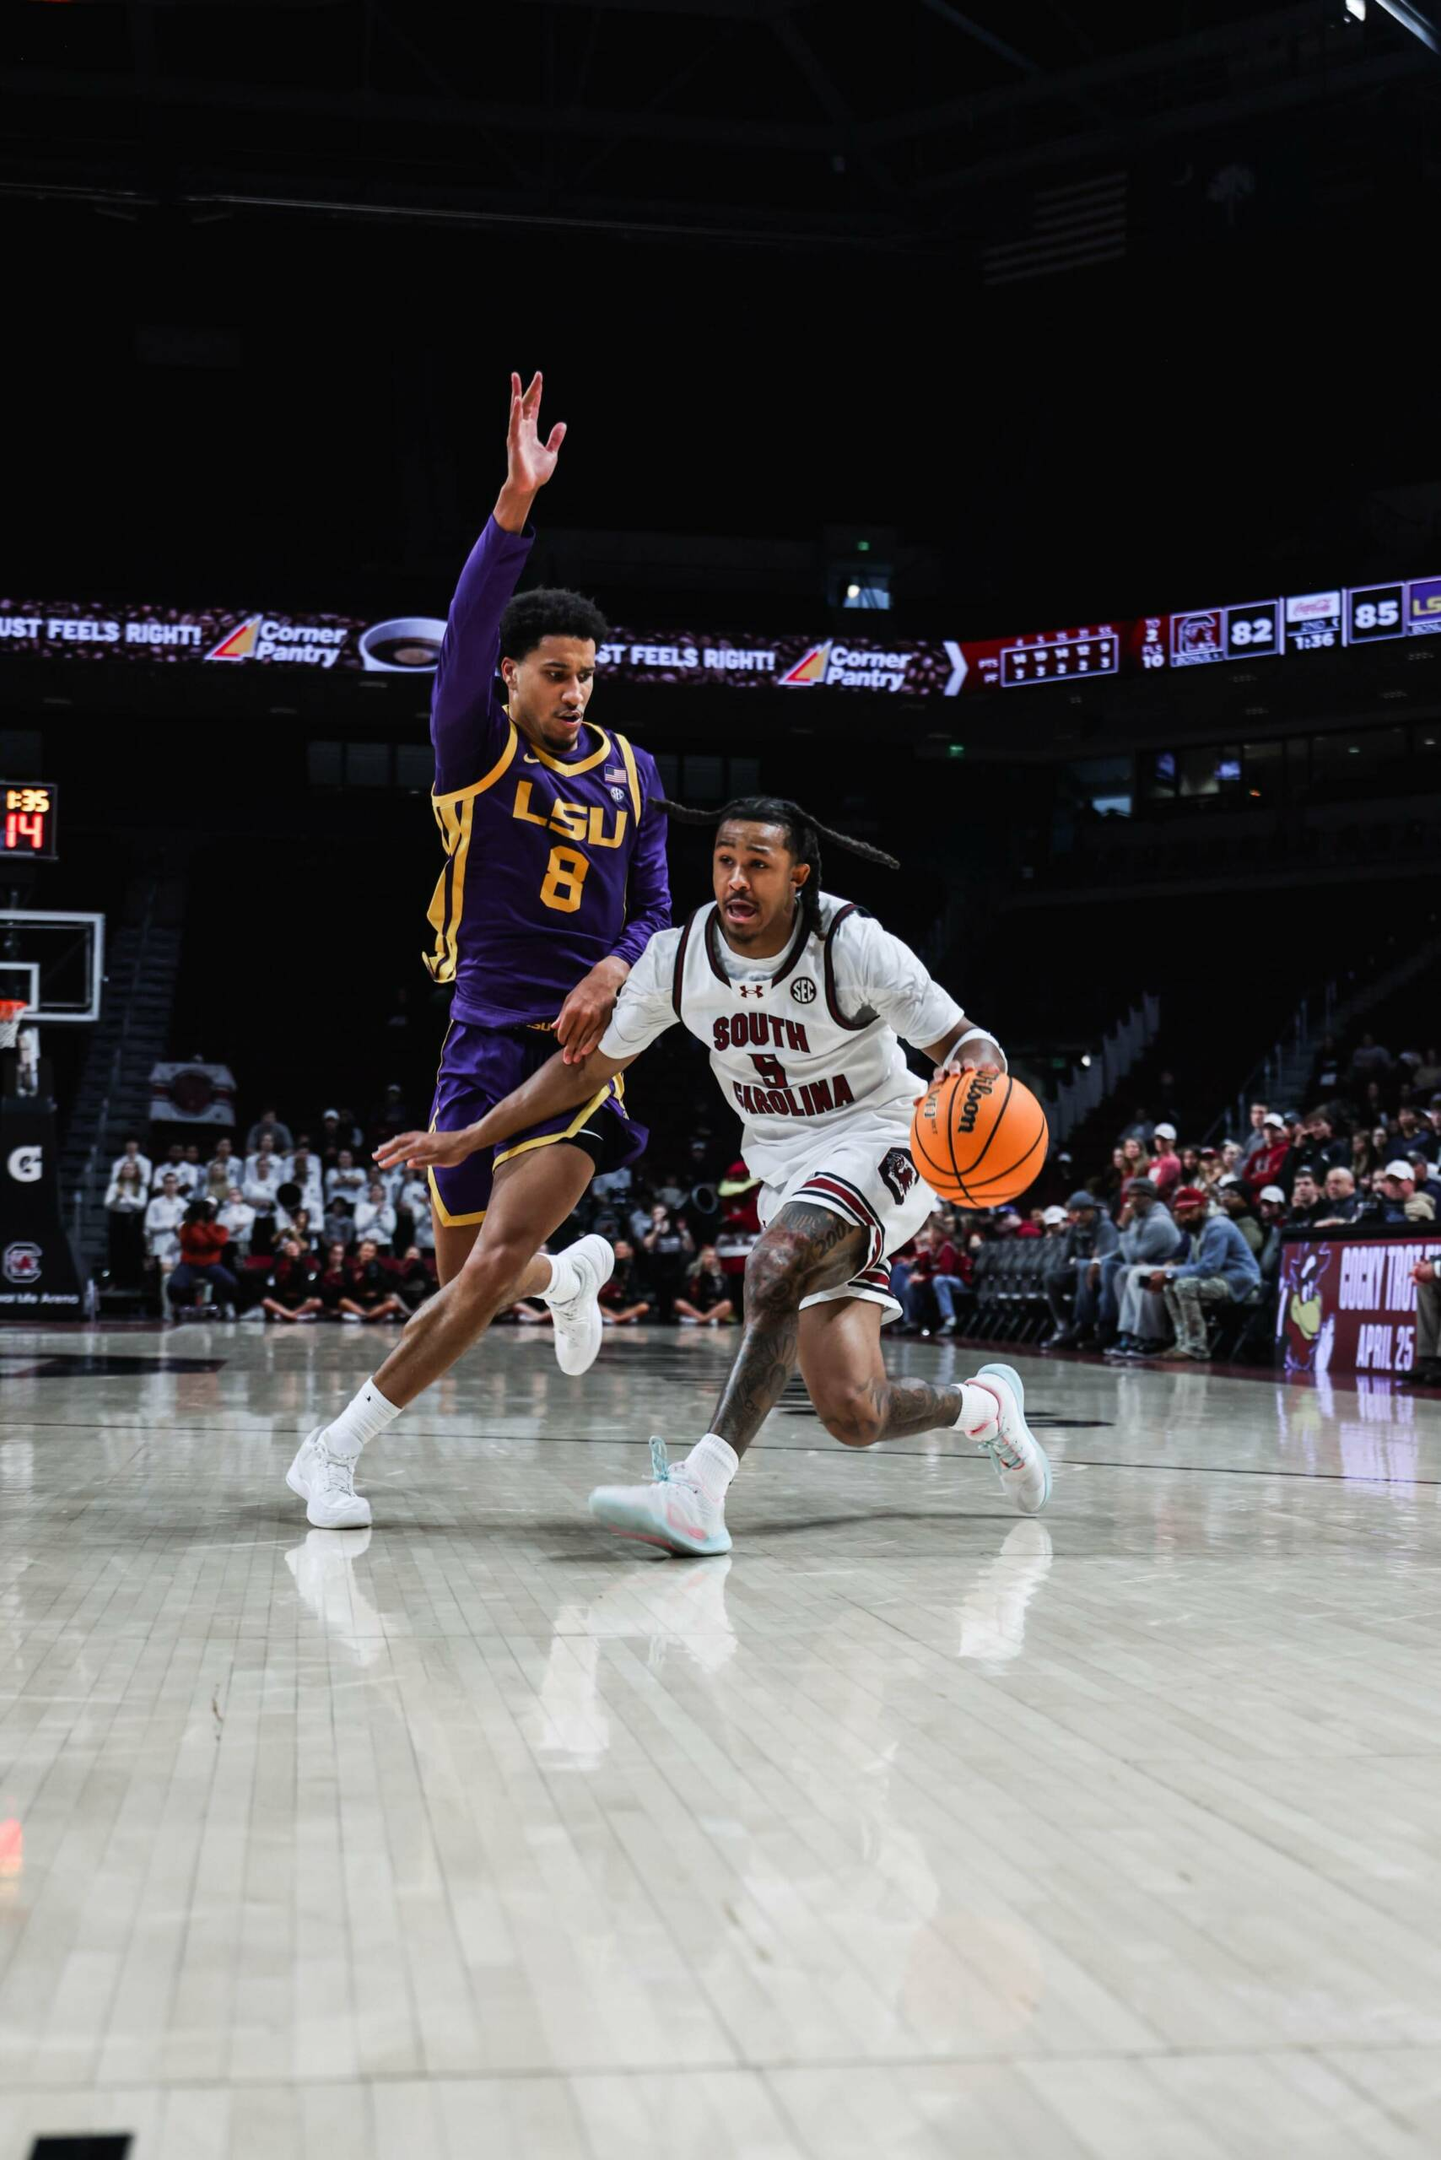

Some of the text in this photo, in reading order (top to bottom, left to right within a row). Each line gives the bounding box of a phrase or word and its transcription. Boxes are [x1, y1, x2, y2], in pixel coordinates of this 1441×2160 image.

[1355, 600, 1399, 629] 85
[47, 619, 120, 642] FEELS
[125, 622, 202, 646] RIGHT!
[260, 620, 348, 645] Corner
[1146, 629, 1159, 642] 2
[1231, 617, 1273, 645] 82
[1294, 632, 1335, 650] 1:36
[256, 642, 341, 668] Pantry
[630, 645, 699, 668] FEELS
[703, 648, 775, 671] RIGHT!
[831, 646, 912, 669] Corner
[978, 658, 999, 669] PTS
[1142, 654, 1165, 668] 10
[826, 667, 905, 692] Pantry
[6, 789, 50, 813] 1:35
[512, 780, 628, 849] LSU
[5, 813, 44, 849] 14
[540, 845, 590, 914] 8
[792, 977, 815, 1003] SEC
[713, 1012, 810, 1054] SOUTH
[748, 1053, 788, 1088] 5
[733, 1073, 856, 1117] CAROLINA
[7, 1145, 43, 1183] G
[16, 1291, 38, 1305] Life
[40, 1291, 80, 1305] Arena
[1355, 1324, 1416, 1372] APRIL 25
